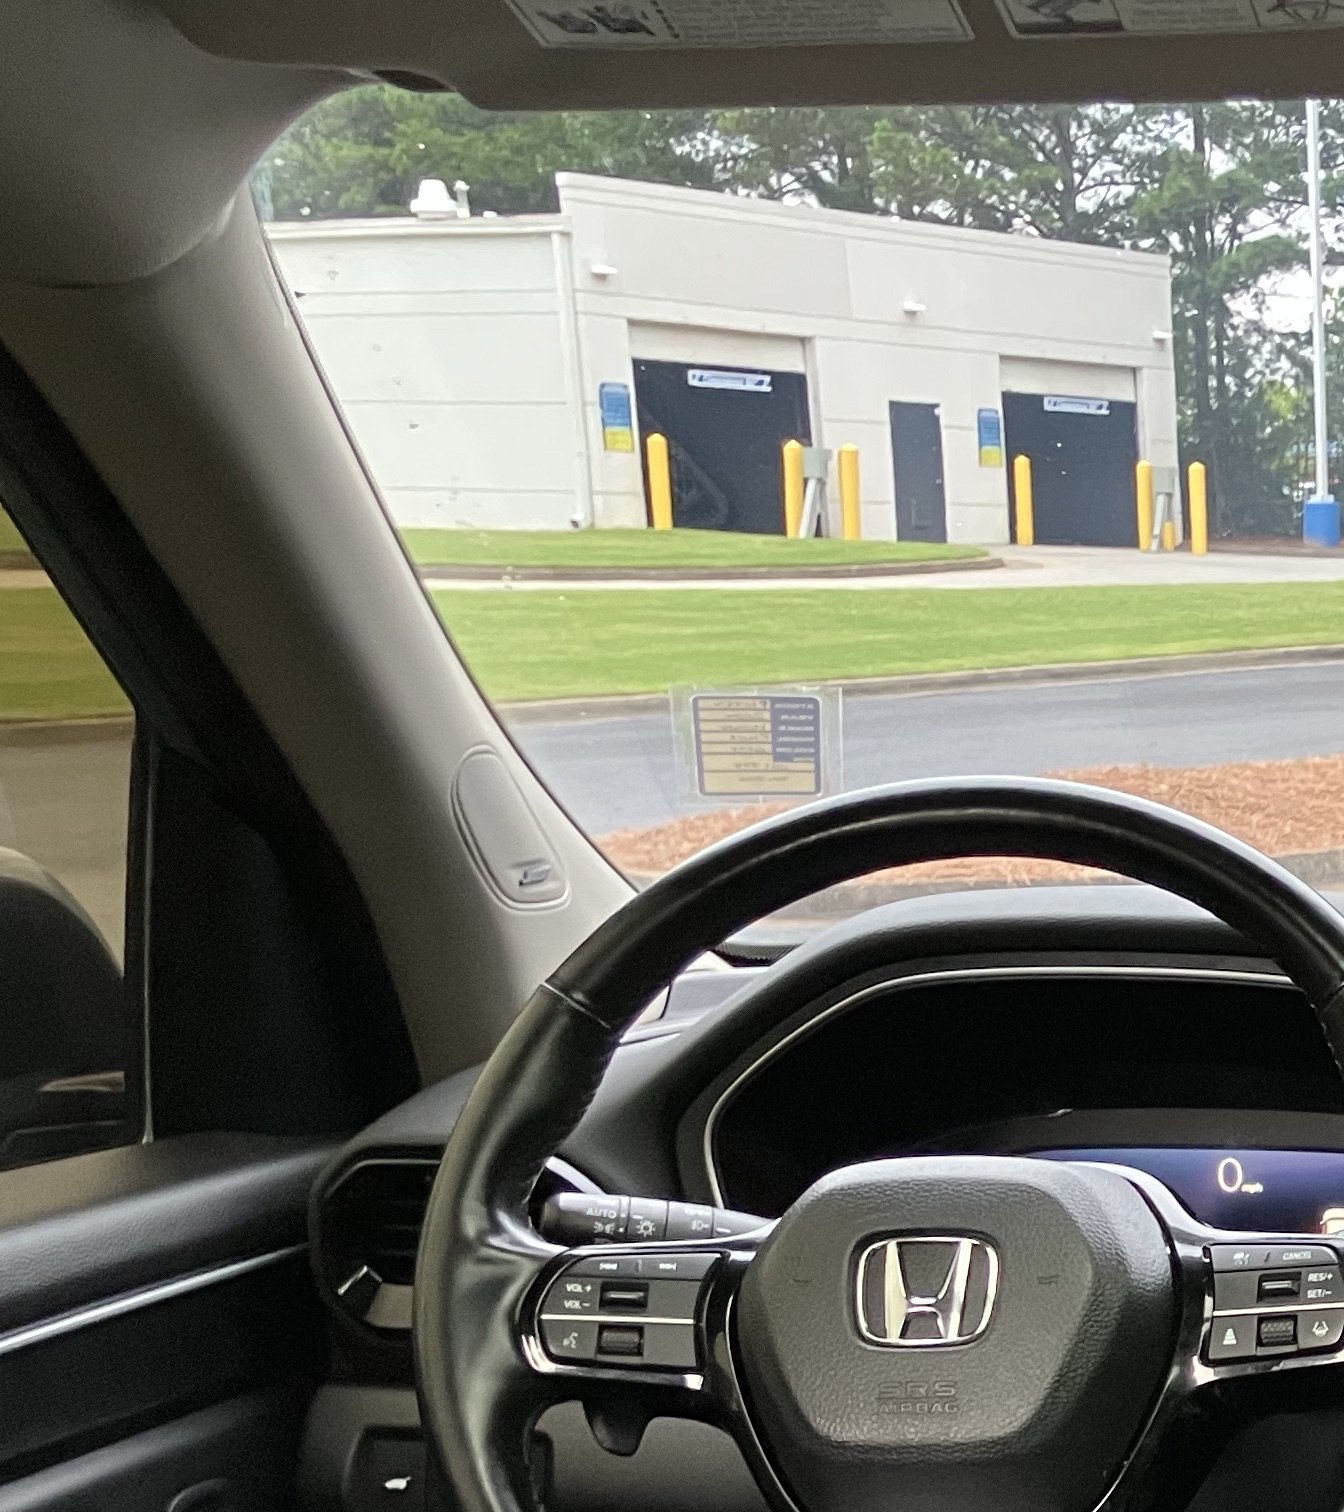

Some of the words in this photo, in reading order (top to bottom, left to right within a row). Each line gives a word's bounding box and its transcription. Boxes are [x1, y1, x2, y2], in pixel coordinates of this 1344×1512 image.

[1218, 1157, 1242, 1192] 0
[586, 1207, 618, 1219] AUTO
[1282, 1251, 1313, 1260] CANCEL
[878, 1381, 958, 1398] SRS
